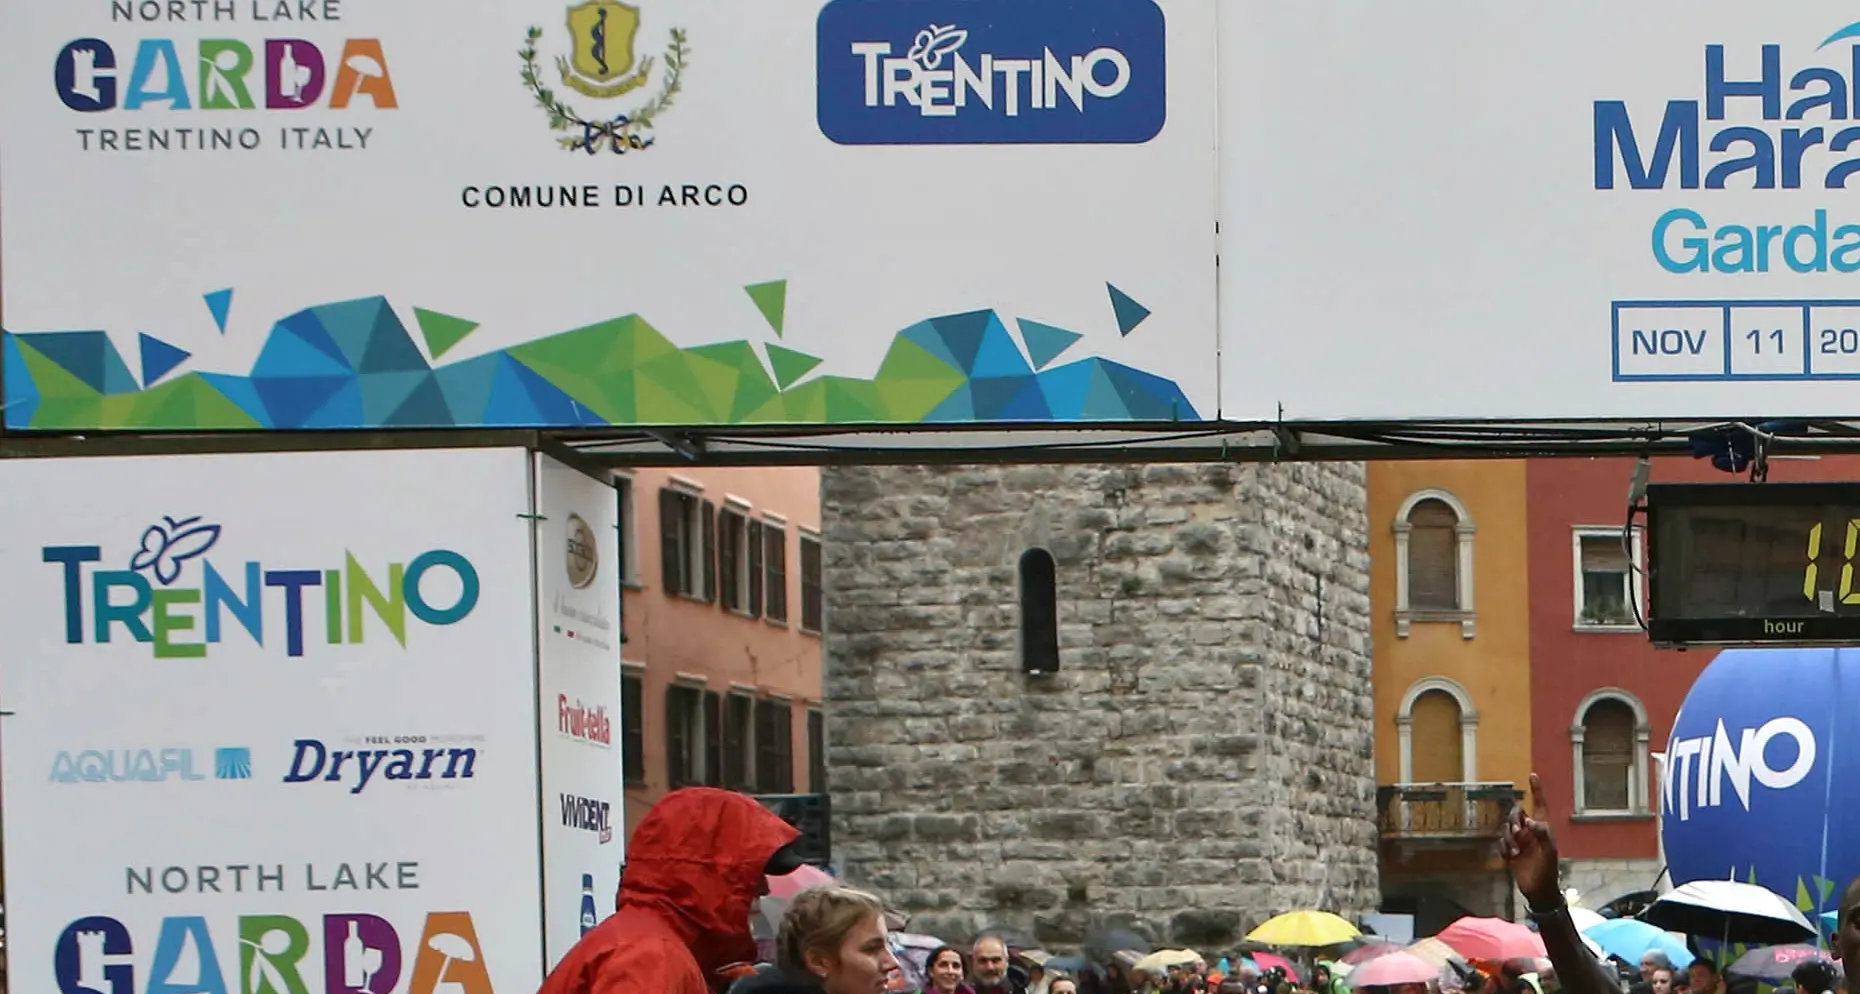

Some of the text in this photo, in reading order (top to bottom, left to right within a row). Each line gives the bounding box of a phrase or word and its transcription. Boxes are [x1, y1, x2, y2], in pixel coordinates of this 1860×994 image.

[111, 0, 342, 21] NORTH LAKE
[55, 38, 399, 111] GARDA
[851, 42, 1131, 116] TRENTINO
[76, 127, 373, 151] TRENTINO ITALY
[462, 184, 749, 208] COMUNE DI ARCO
[1632, 329, 1706, 354] NOV
[1746, 328, 1785, 354] 11
[42, 546, 480, 658] TRENTINO
[1764, 618, 1804, 634] hour
[49, 750, 204, 783] AQUAFIL
[283, 739, 477, 793] Dryarn
[1661, 717, 1816, 821] NTINO
[126, 862, 421, 894] NORTH LAKE
